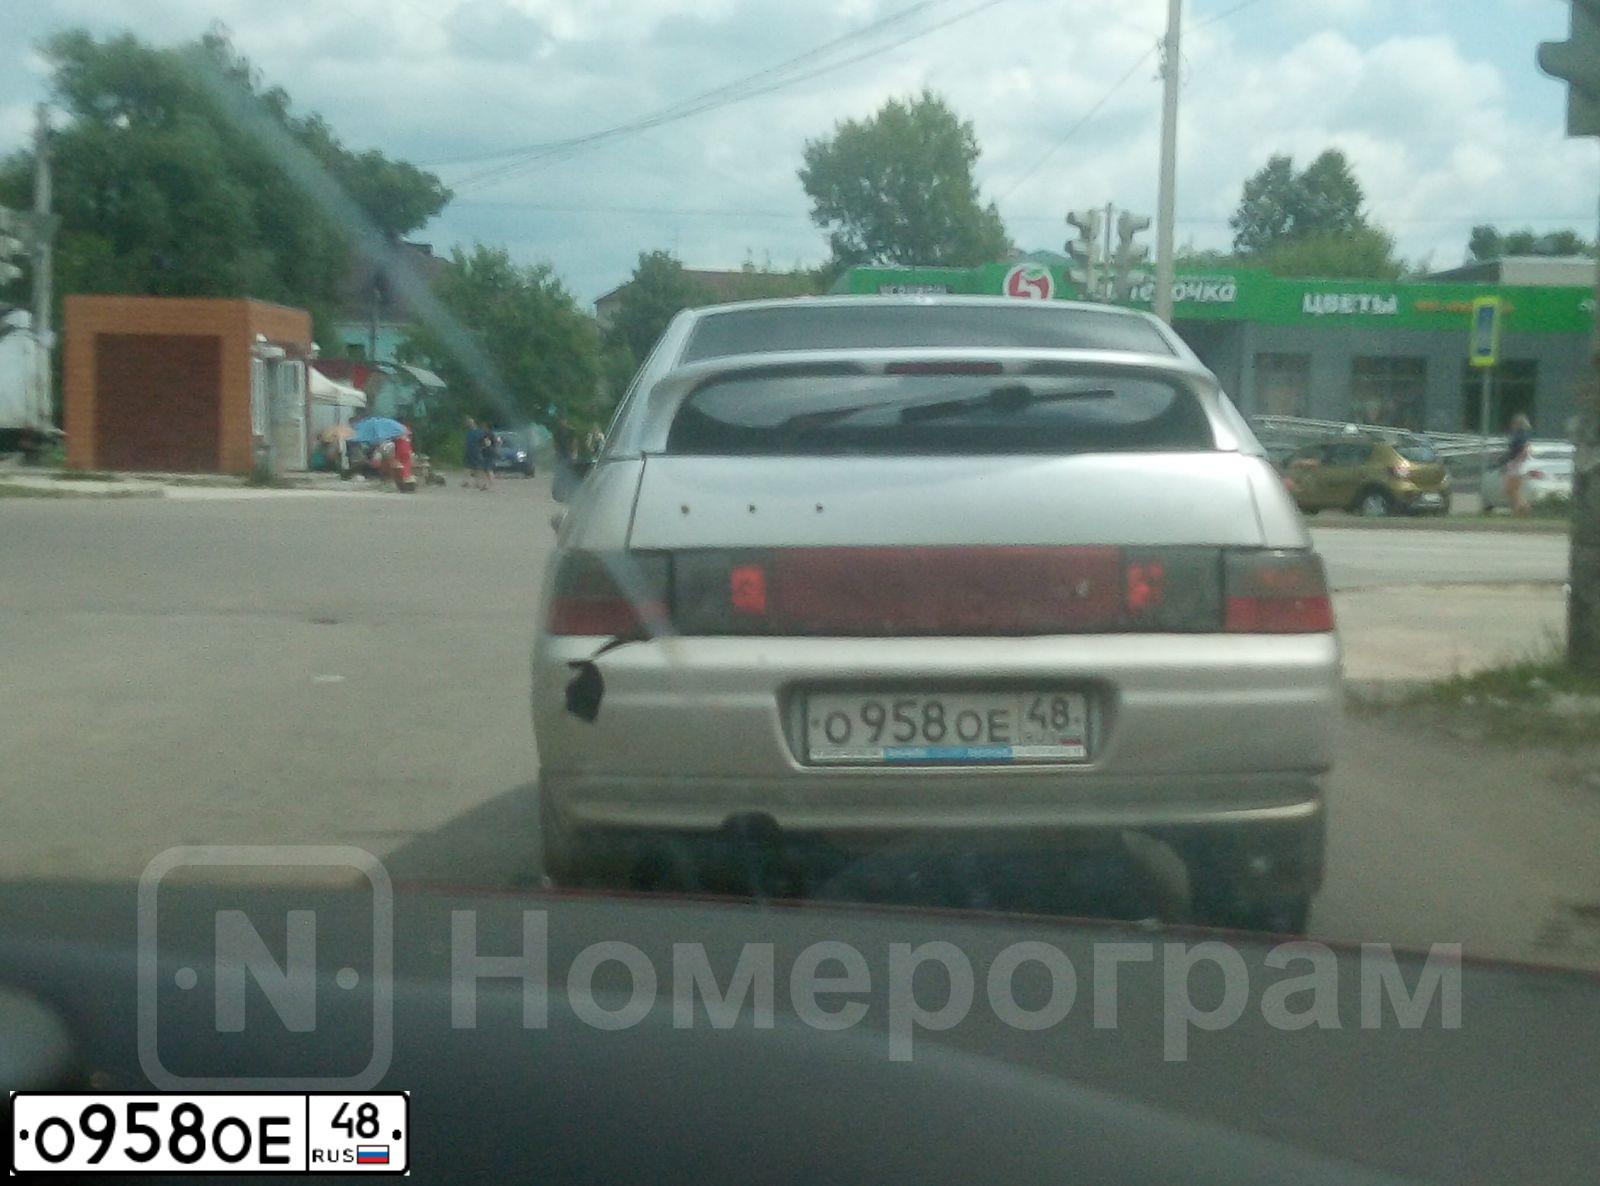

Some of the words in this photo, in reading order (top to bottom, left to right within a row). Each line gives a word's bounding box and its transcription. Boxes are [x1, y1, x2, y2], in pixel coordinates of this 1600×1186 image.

[1302, 293, 1398, 315] ЦВЕТЫ
[825, 701, 1010, 746] О958ОЕ
[1027, 697, 1070, 729] 48
